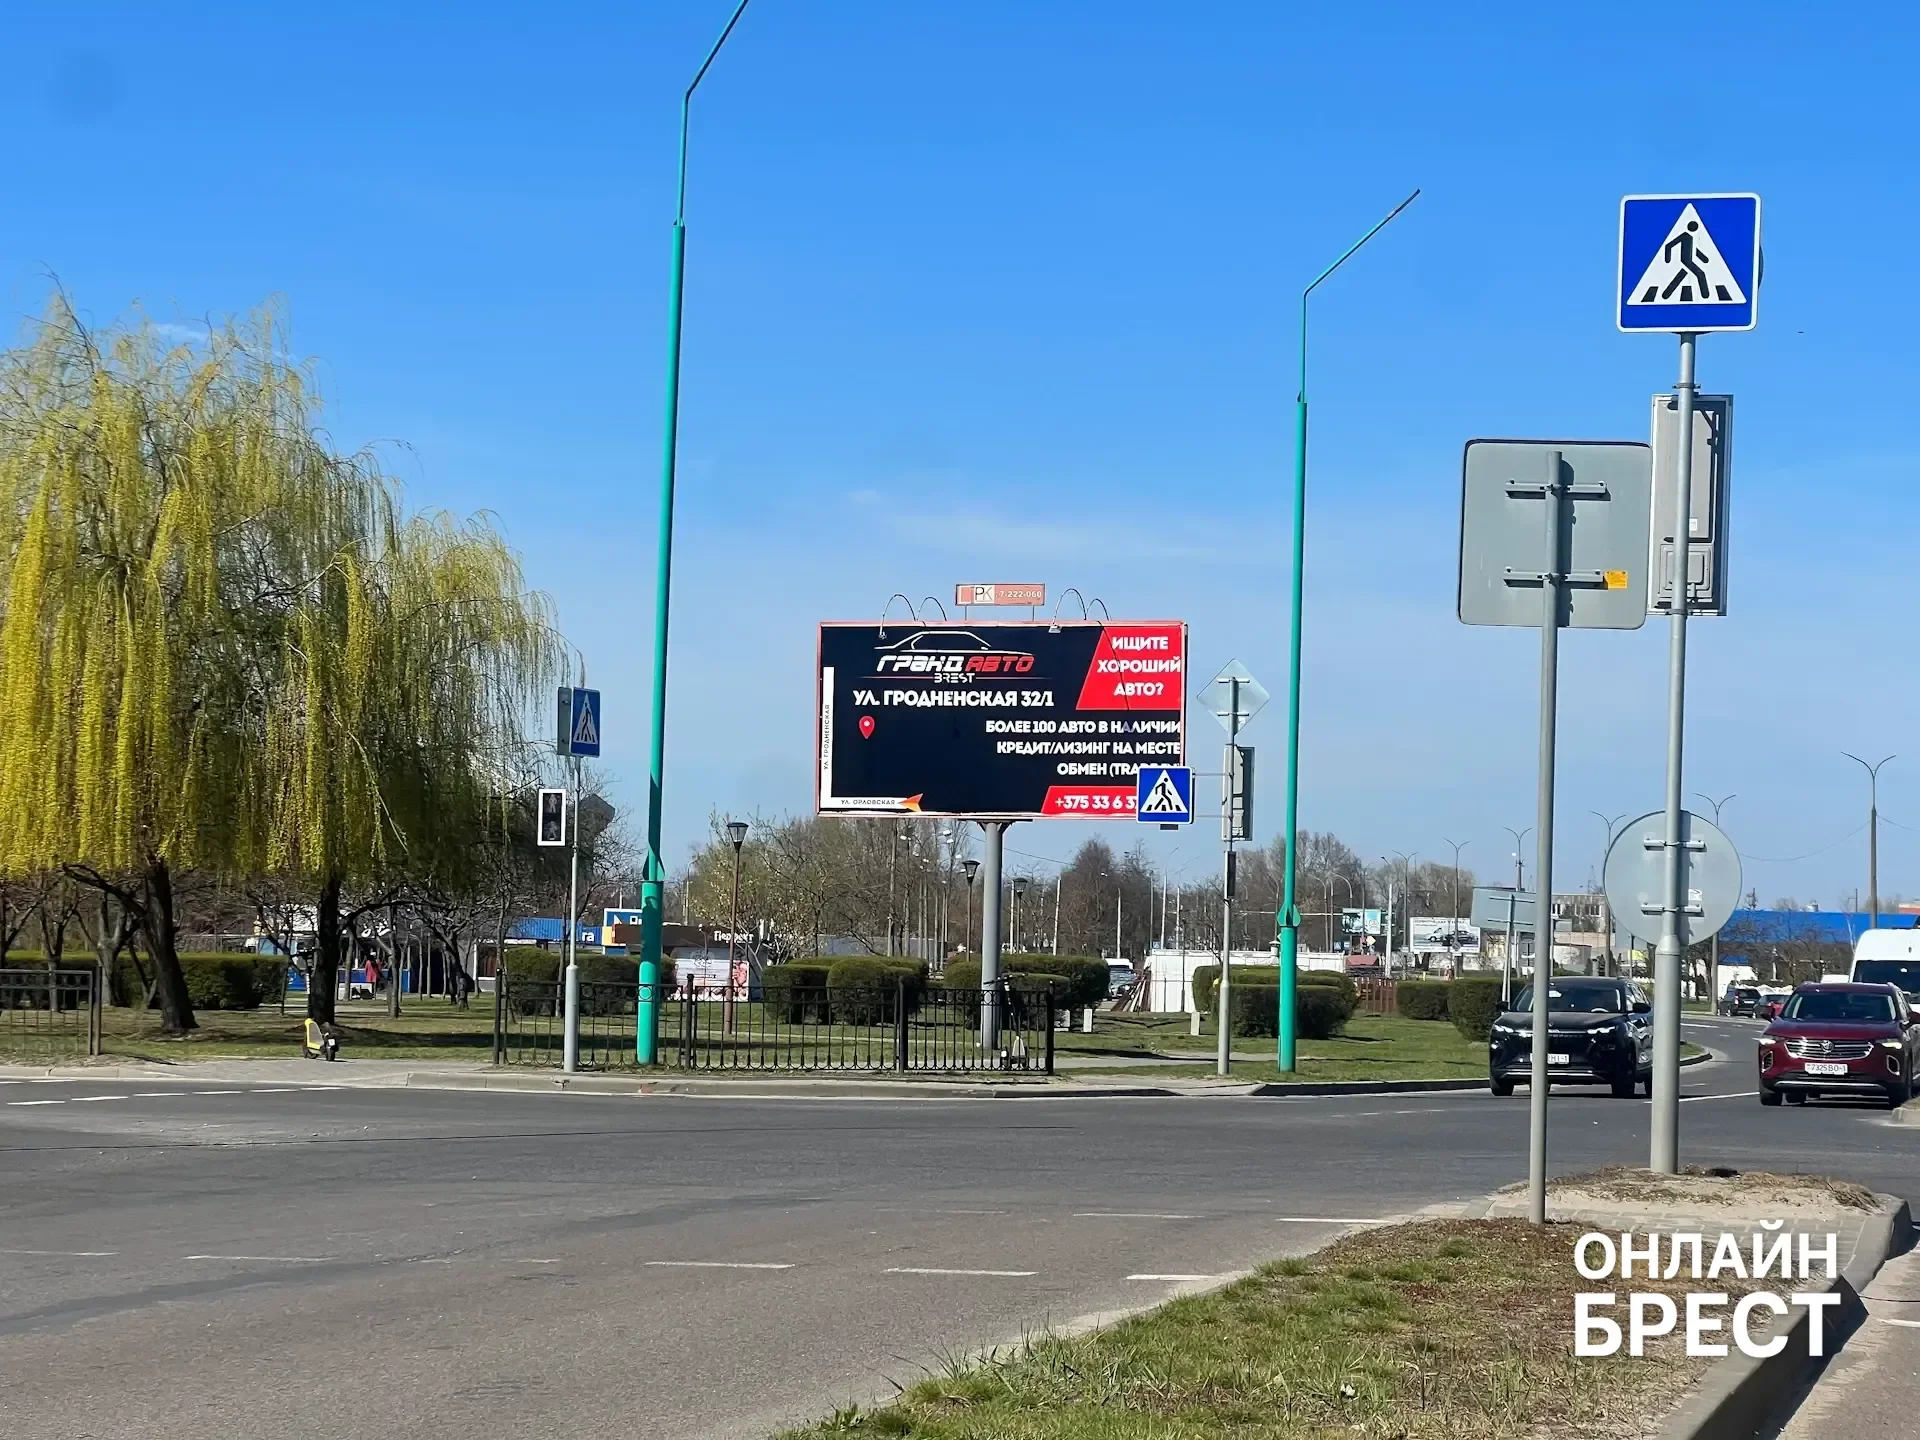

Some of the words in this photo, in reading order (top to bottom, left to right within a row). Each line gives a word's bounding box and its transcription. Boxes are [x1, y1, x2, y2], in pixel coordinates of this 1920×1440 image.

[1111, 636, 1169, 651] ИЩИТЕ
[876, 655, 965, 672] ГРАНД
[965, 656, 1035, 672] АВТО
[1096, 655, 1182, 673] ХОРОШИЙ
[934, 672, 976, 684] BREST
[1113, 682, 1165, 696] АВТО?
[852, 690, 881, 706] УЛ.
[883, 690, 1017, 708] ГРОДНЕНСКАЯ
[1020, 691, 1054, 708] 32/1
[823, 704, 831, 758] ГРОДНЕНСКАЯ
[985, 720, 1032, 733] БОЛЕЕ
[1032, 720, 1057, 733] 100
[1057, 720, 1097, 734] АВТО
[1098, 720, 1108, 733] В
[1110, 720, 1181, 734] НАЛИЧИИ
[996, 741, 1111, 755] КРЕДИТ/ЛИЗИНГ
[1112, 741, 1132, 755] НА
[1135, 741, 1181, 755] МЕСТЕ
[1057, 762, 1108, 776] ОБМЕН
[1054, 794, 1090, 809] +375
[1091, 795, 1111, 809] 33
[1112, 795, 1124, 809] 6
